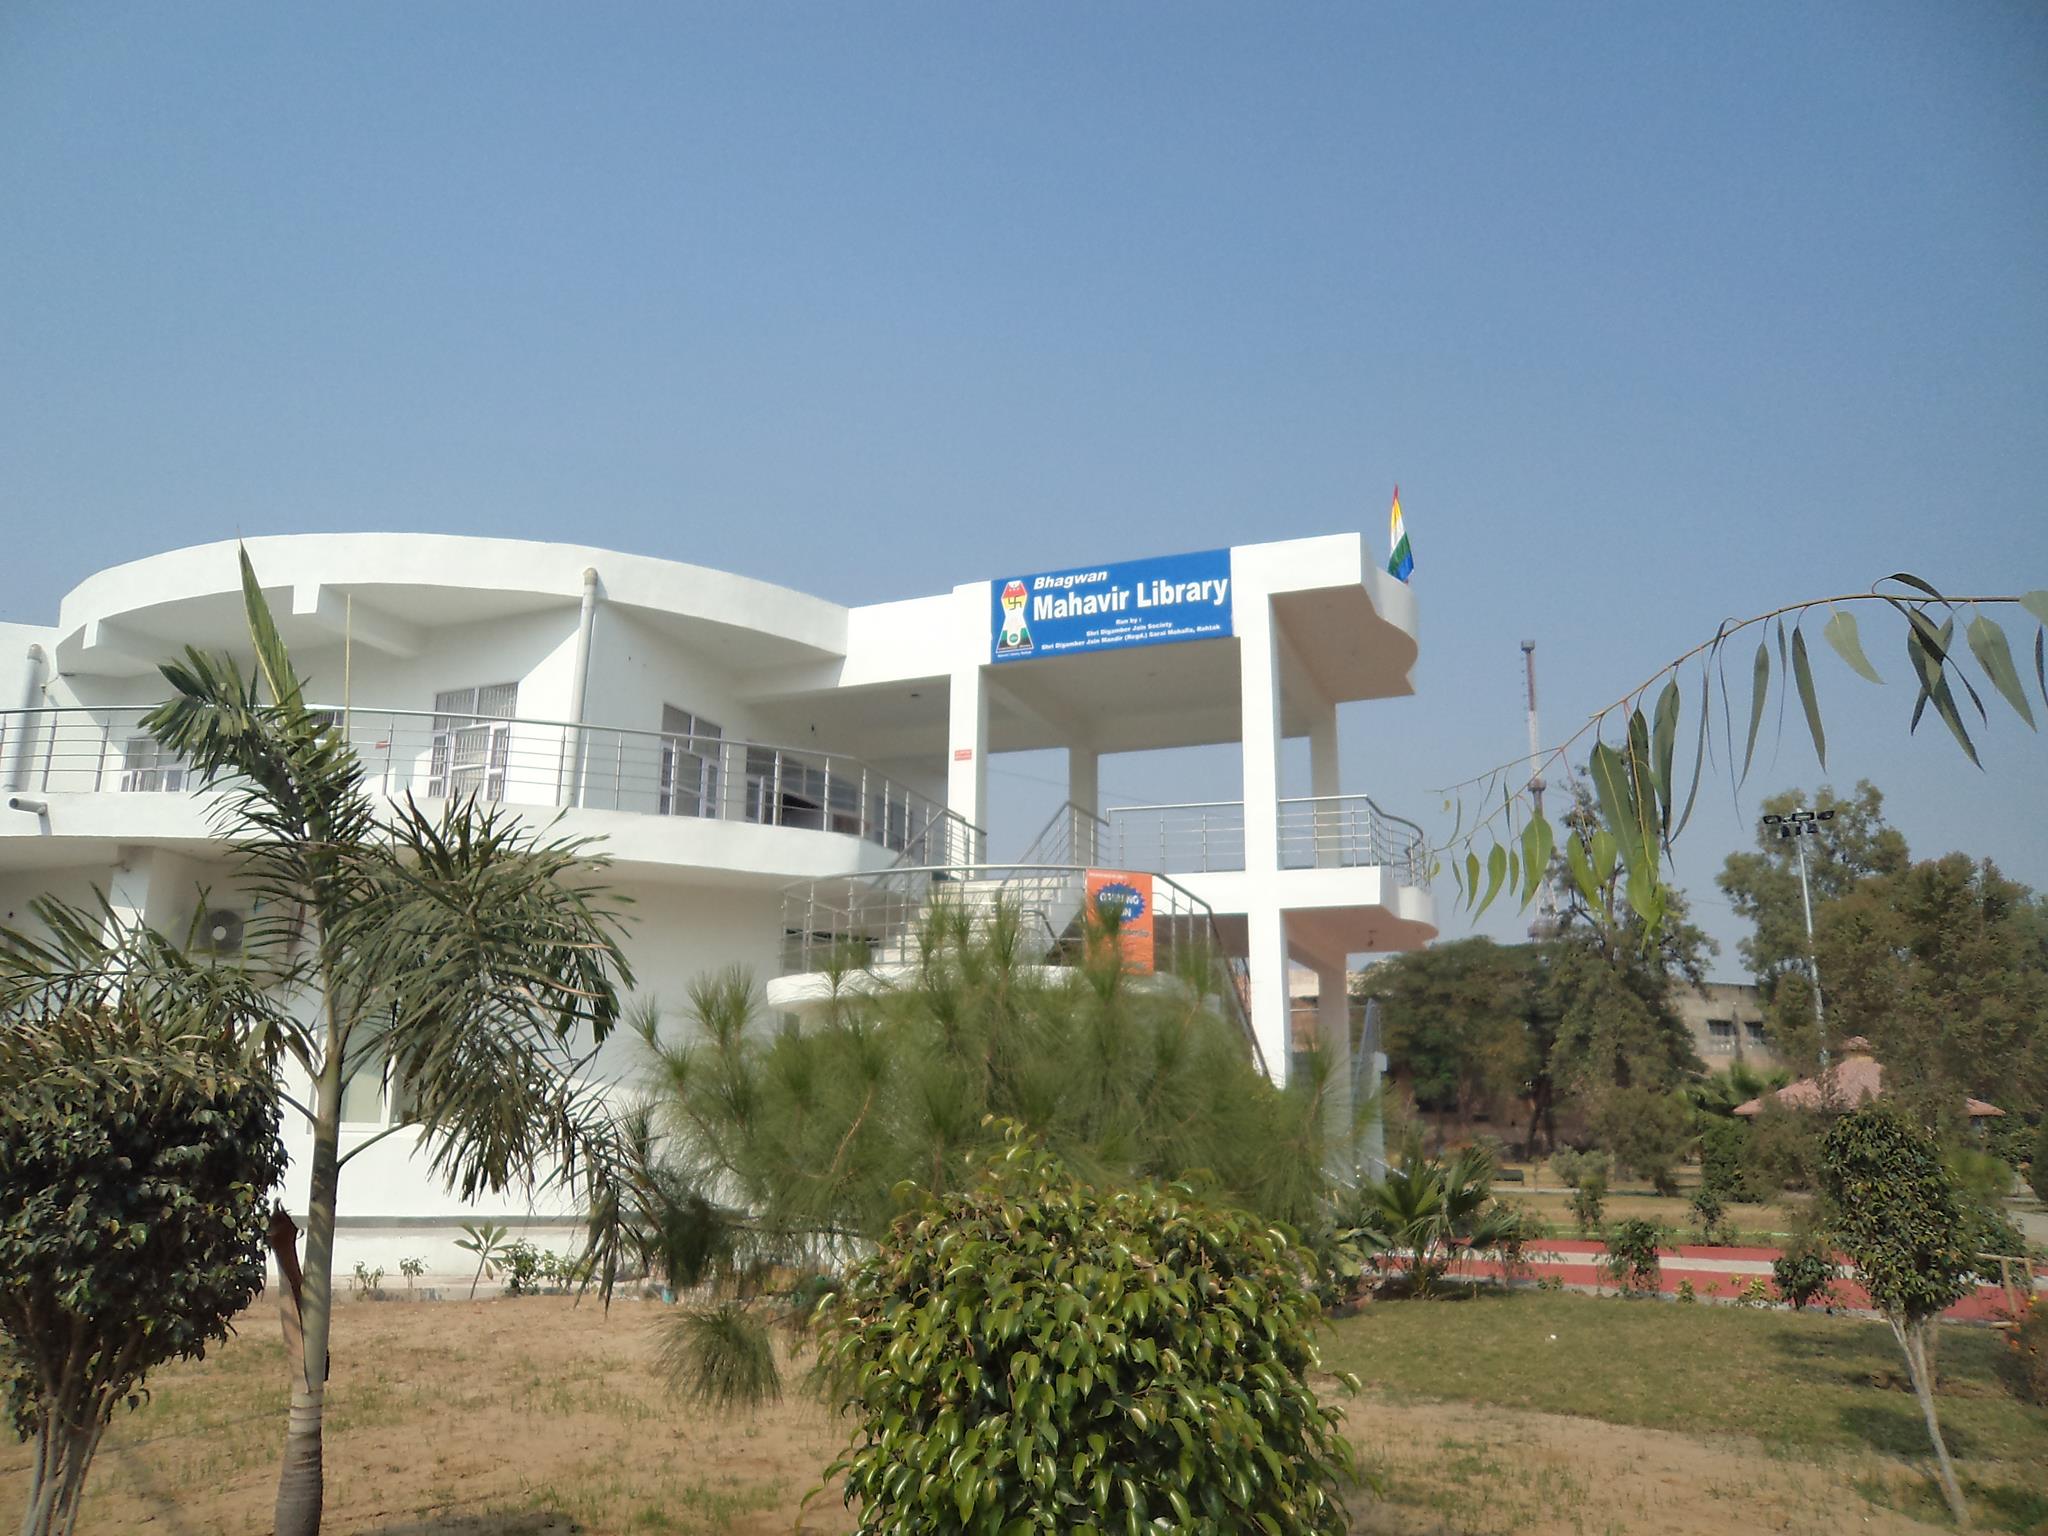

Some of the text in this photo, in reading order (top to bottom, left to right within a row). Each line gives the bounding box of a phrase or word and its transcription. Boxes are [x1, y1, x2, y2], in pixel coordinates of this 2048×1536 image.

[1033, 571, 1108, 590] Bhagwan
[1033, 577, 1228, 621] Mahavir Library
